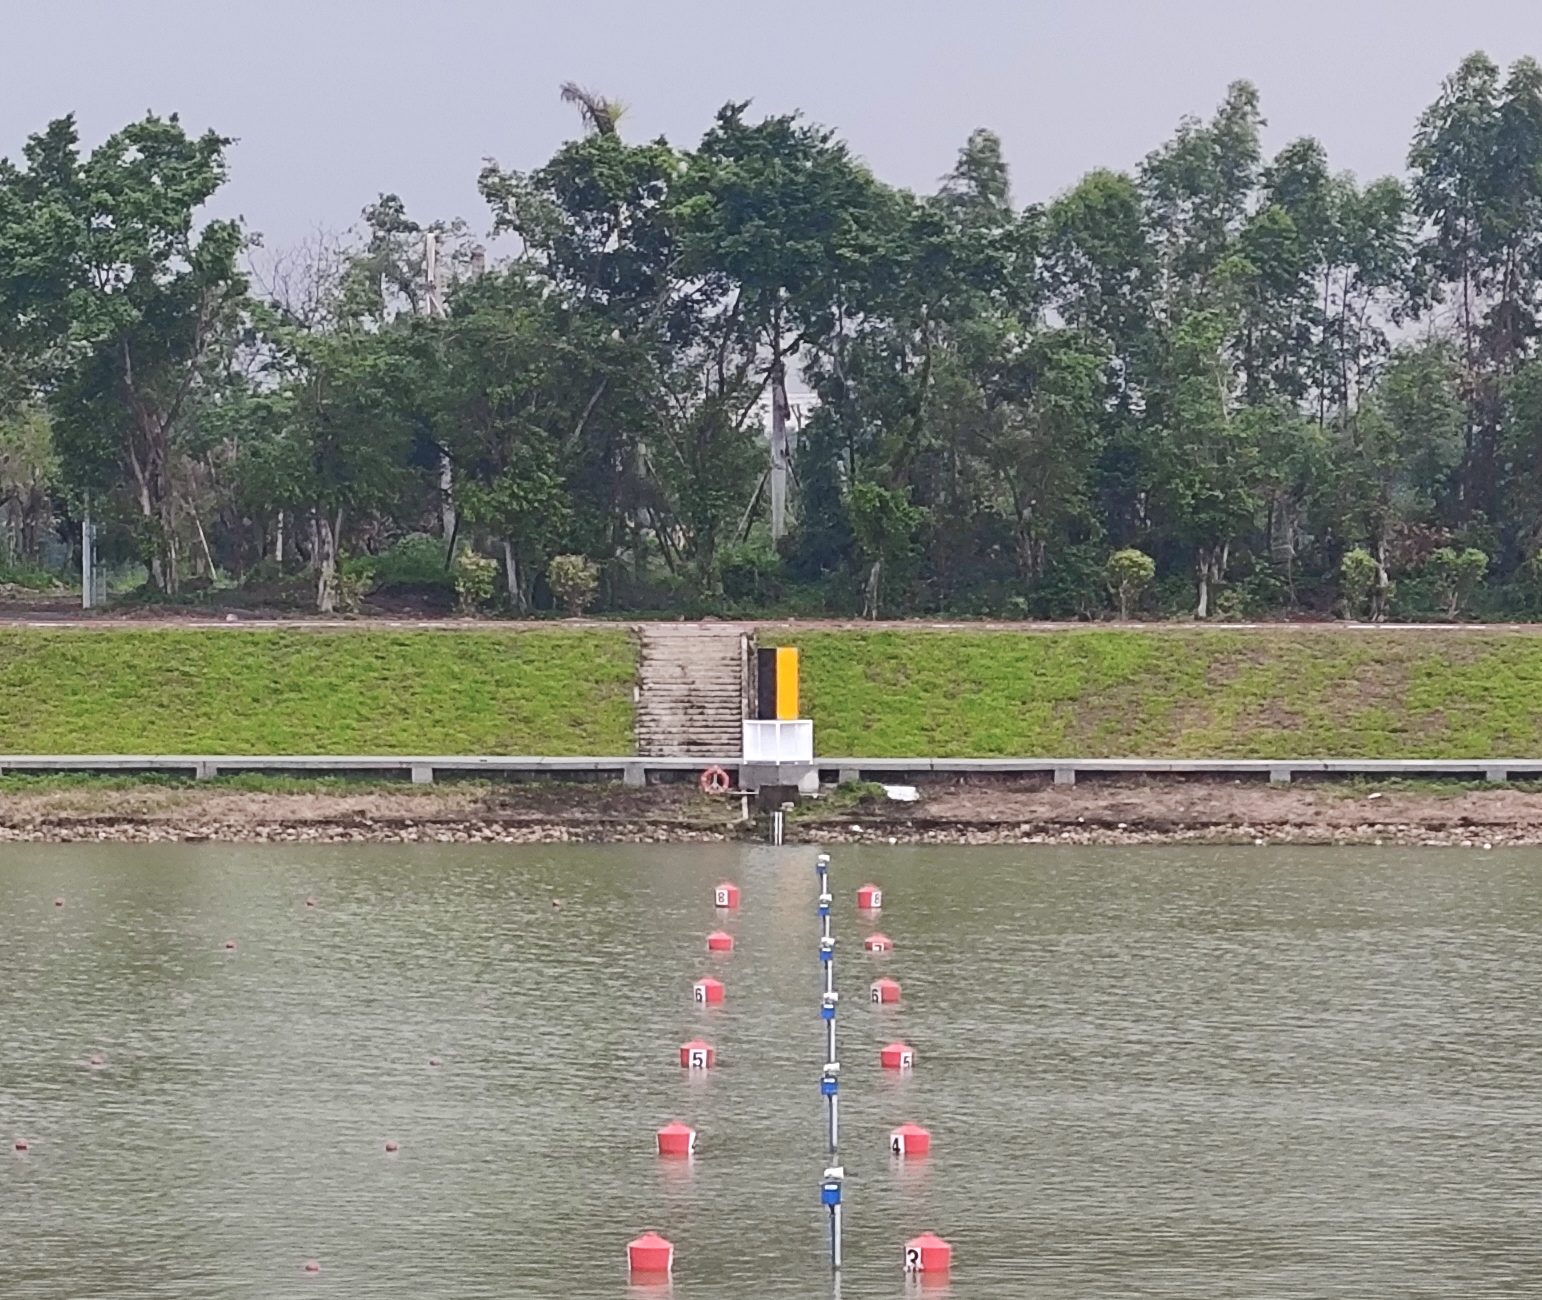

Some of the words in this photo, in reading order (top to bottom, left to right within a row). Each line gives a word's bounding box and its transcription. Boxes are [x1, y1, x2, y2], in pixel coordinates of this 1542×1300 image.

[718, 892, 726, 904] 8
[695, 988, 703, 1003] 6
[871, 988, 879, 1004] 6
[693, 1052, 704, 1070] 5
[903, 1055, 911, 1069] 5
[892, 1137, 901, 1154] 4
